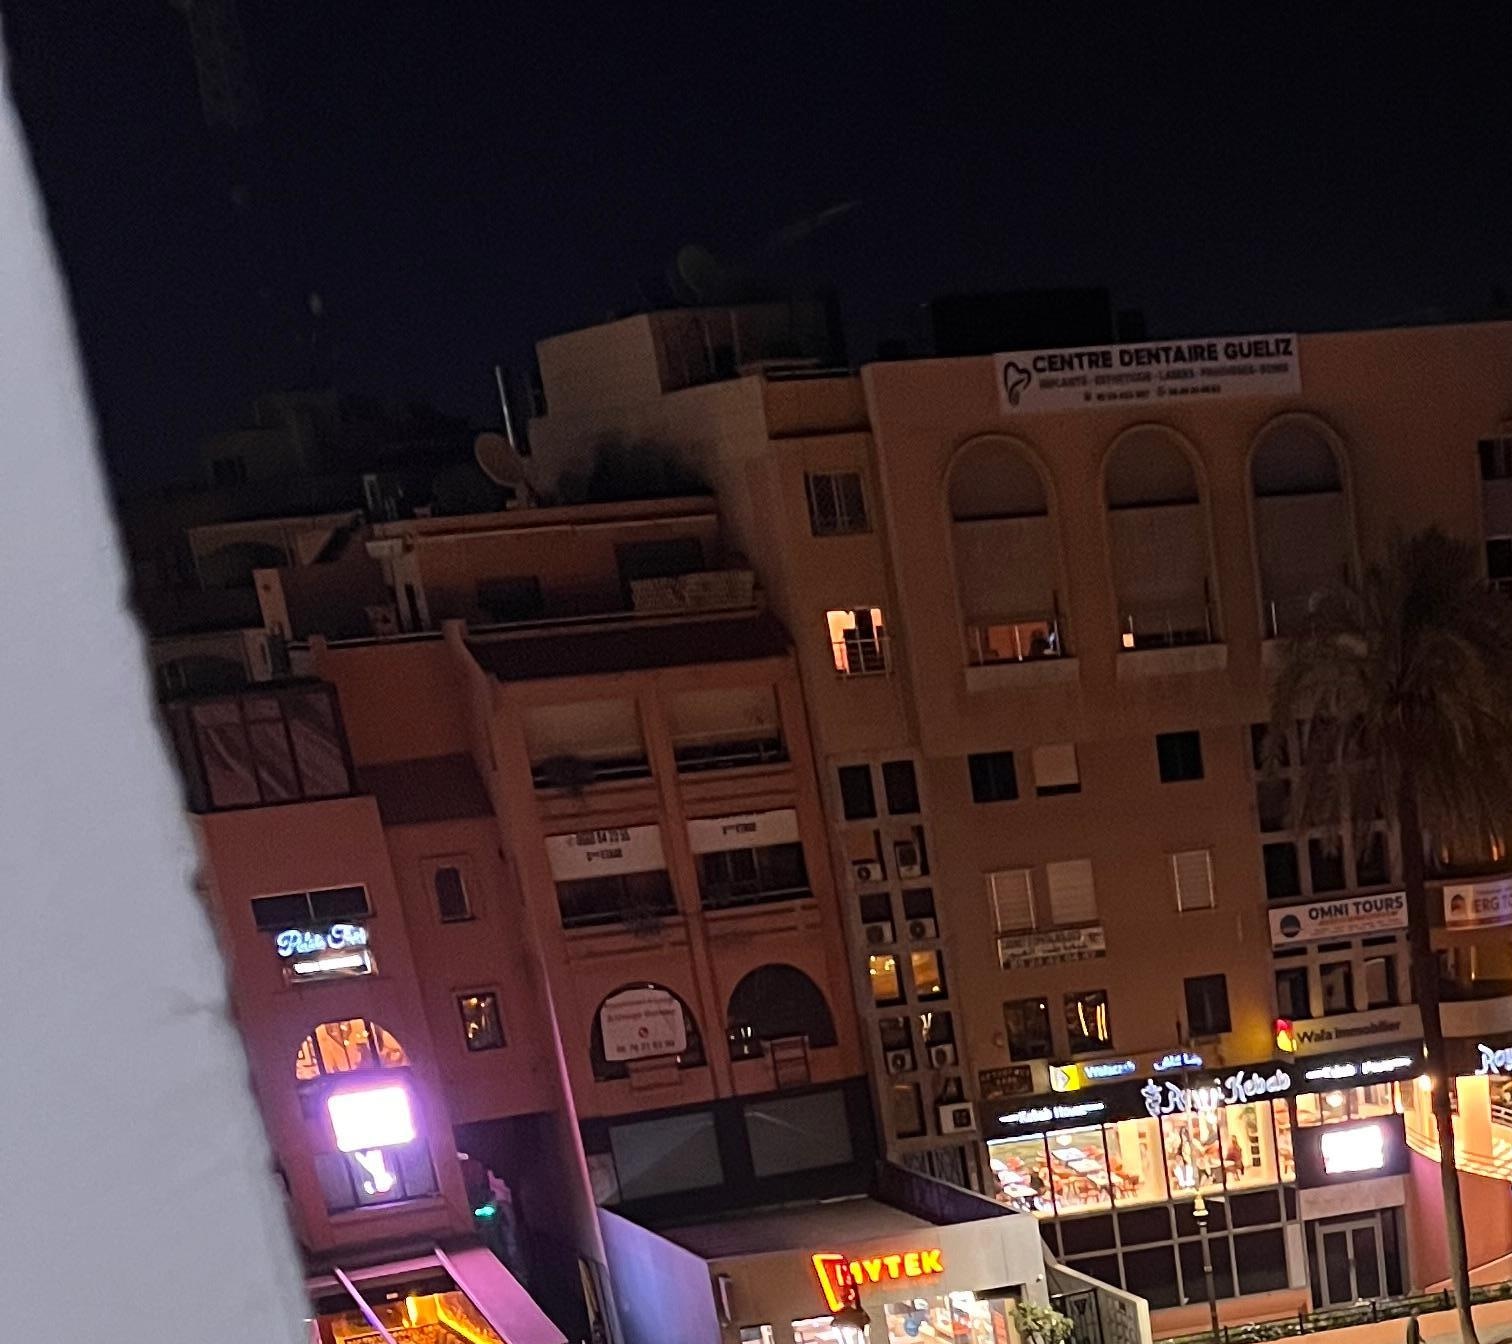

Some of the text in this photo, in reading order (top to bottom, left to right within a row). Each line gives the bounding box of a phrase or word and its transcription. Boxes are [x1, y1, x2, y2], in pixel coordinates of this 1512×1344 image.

[1032, 338, 1293, 373] CENTRE DENTAIRE GUELIZ
[1308, 904, 1349, 921] OMNI
[1354, 895, 1404, 914] TOURS
[1475, 895, 1499, 914] ERG
[1224, 1069, 1291, 1104] Kebab
[834, 1248, 944, 1287] MYTEK
